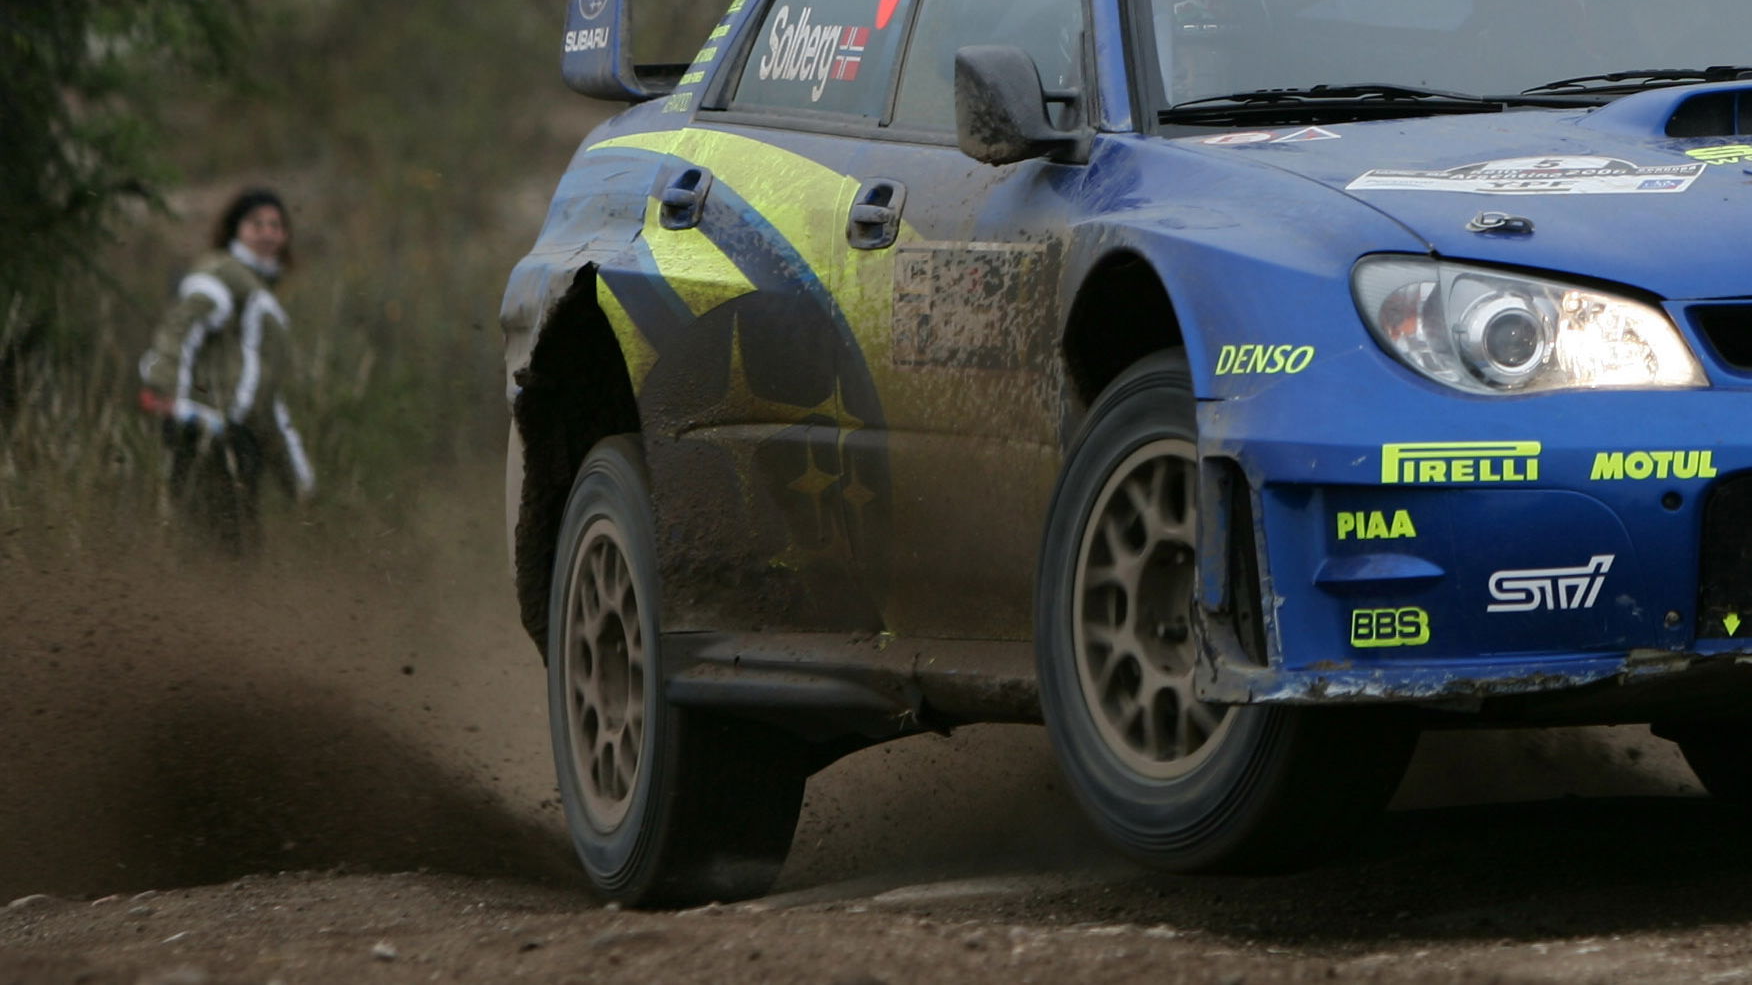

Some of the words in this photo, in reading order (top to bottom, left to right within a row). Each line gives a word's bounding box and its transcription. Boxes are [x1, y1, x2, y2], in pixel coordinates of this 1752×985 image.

[564, 27, 610, 53] SUBARU
[759, 5, 843, 102] Solberg
[1533, 159, 1564, 169] 5
[1215, 345, 1314, 376] DENSO
[1381, 441, 1542, 484] PIRELLI
[1590, 450, 1718, 481] MOTUL
[1337, 510, 1416, 540] PIAA
[1351, 608, 1430, 648] BBS
